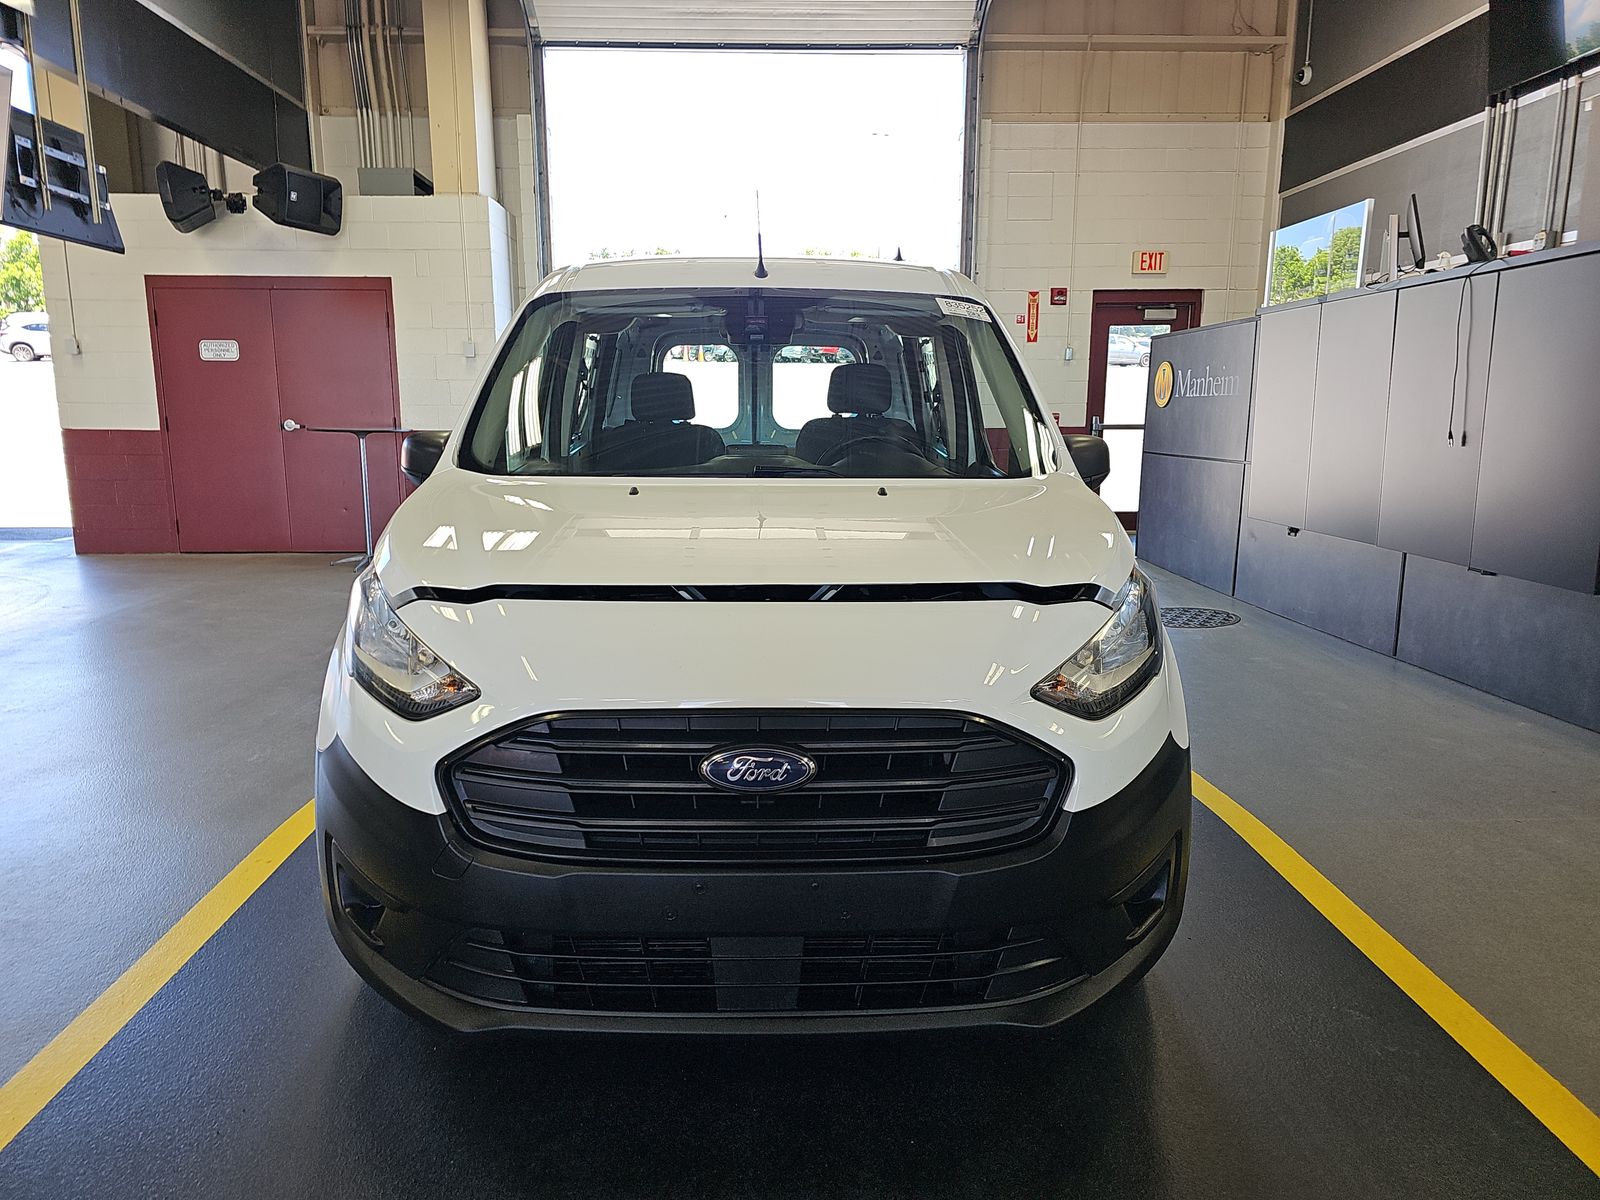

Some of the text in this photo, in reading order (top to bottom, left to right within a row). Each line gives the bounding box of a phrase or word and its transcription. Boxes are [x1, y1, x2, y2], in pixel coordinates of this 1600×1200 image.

[1140, 252, 1165, 271] EXIT
[1174, 365, 1240, 398] Manheim
[726, 755, 792, 782] Ford
